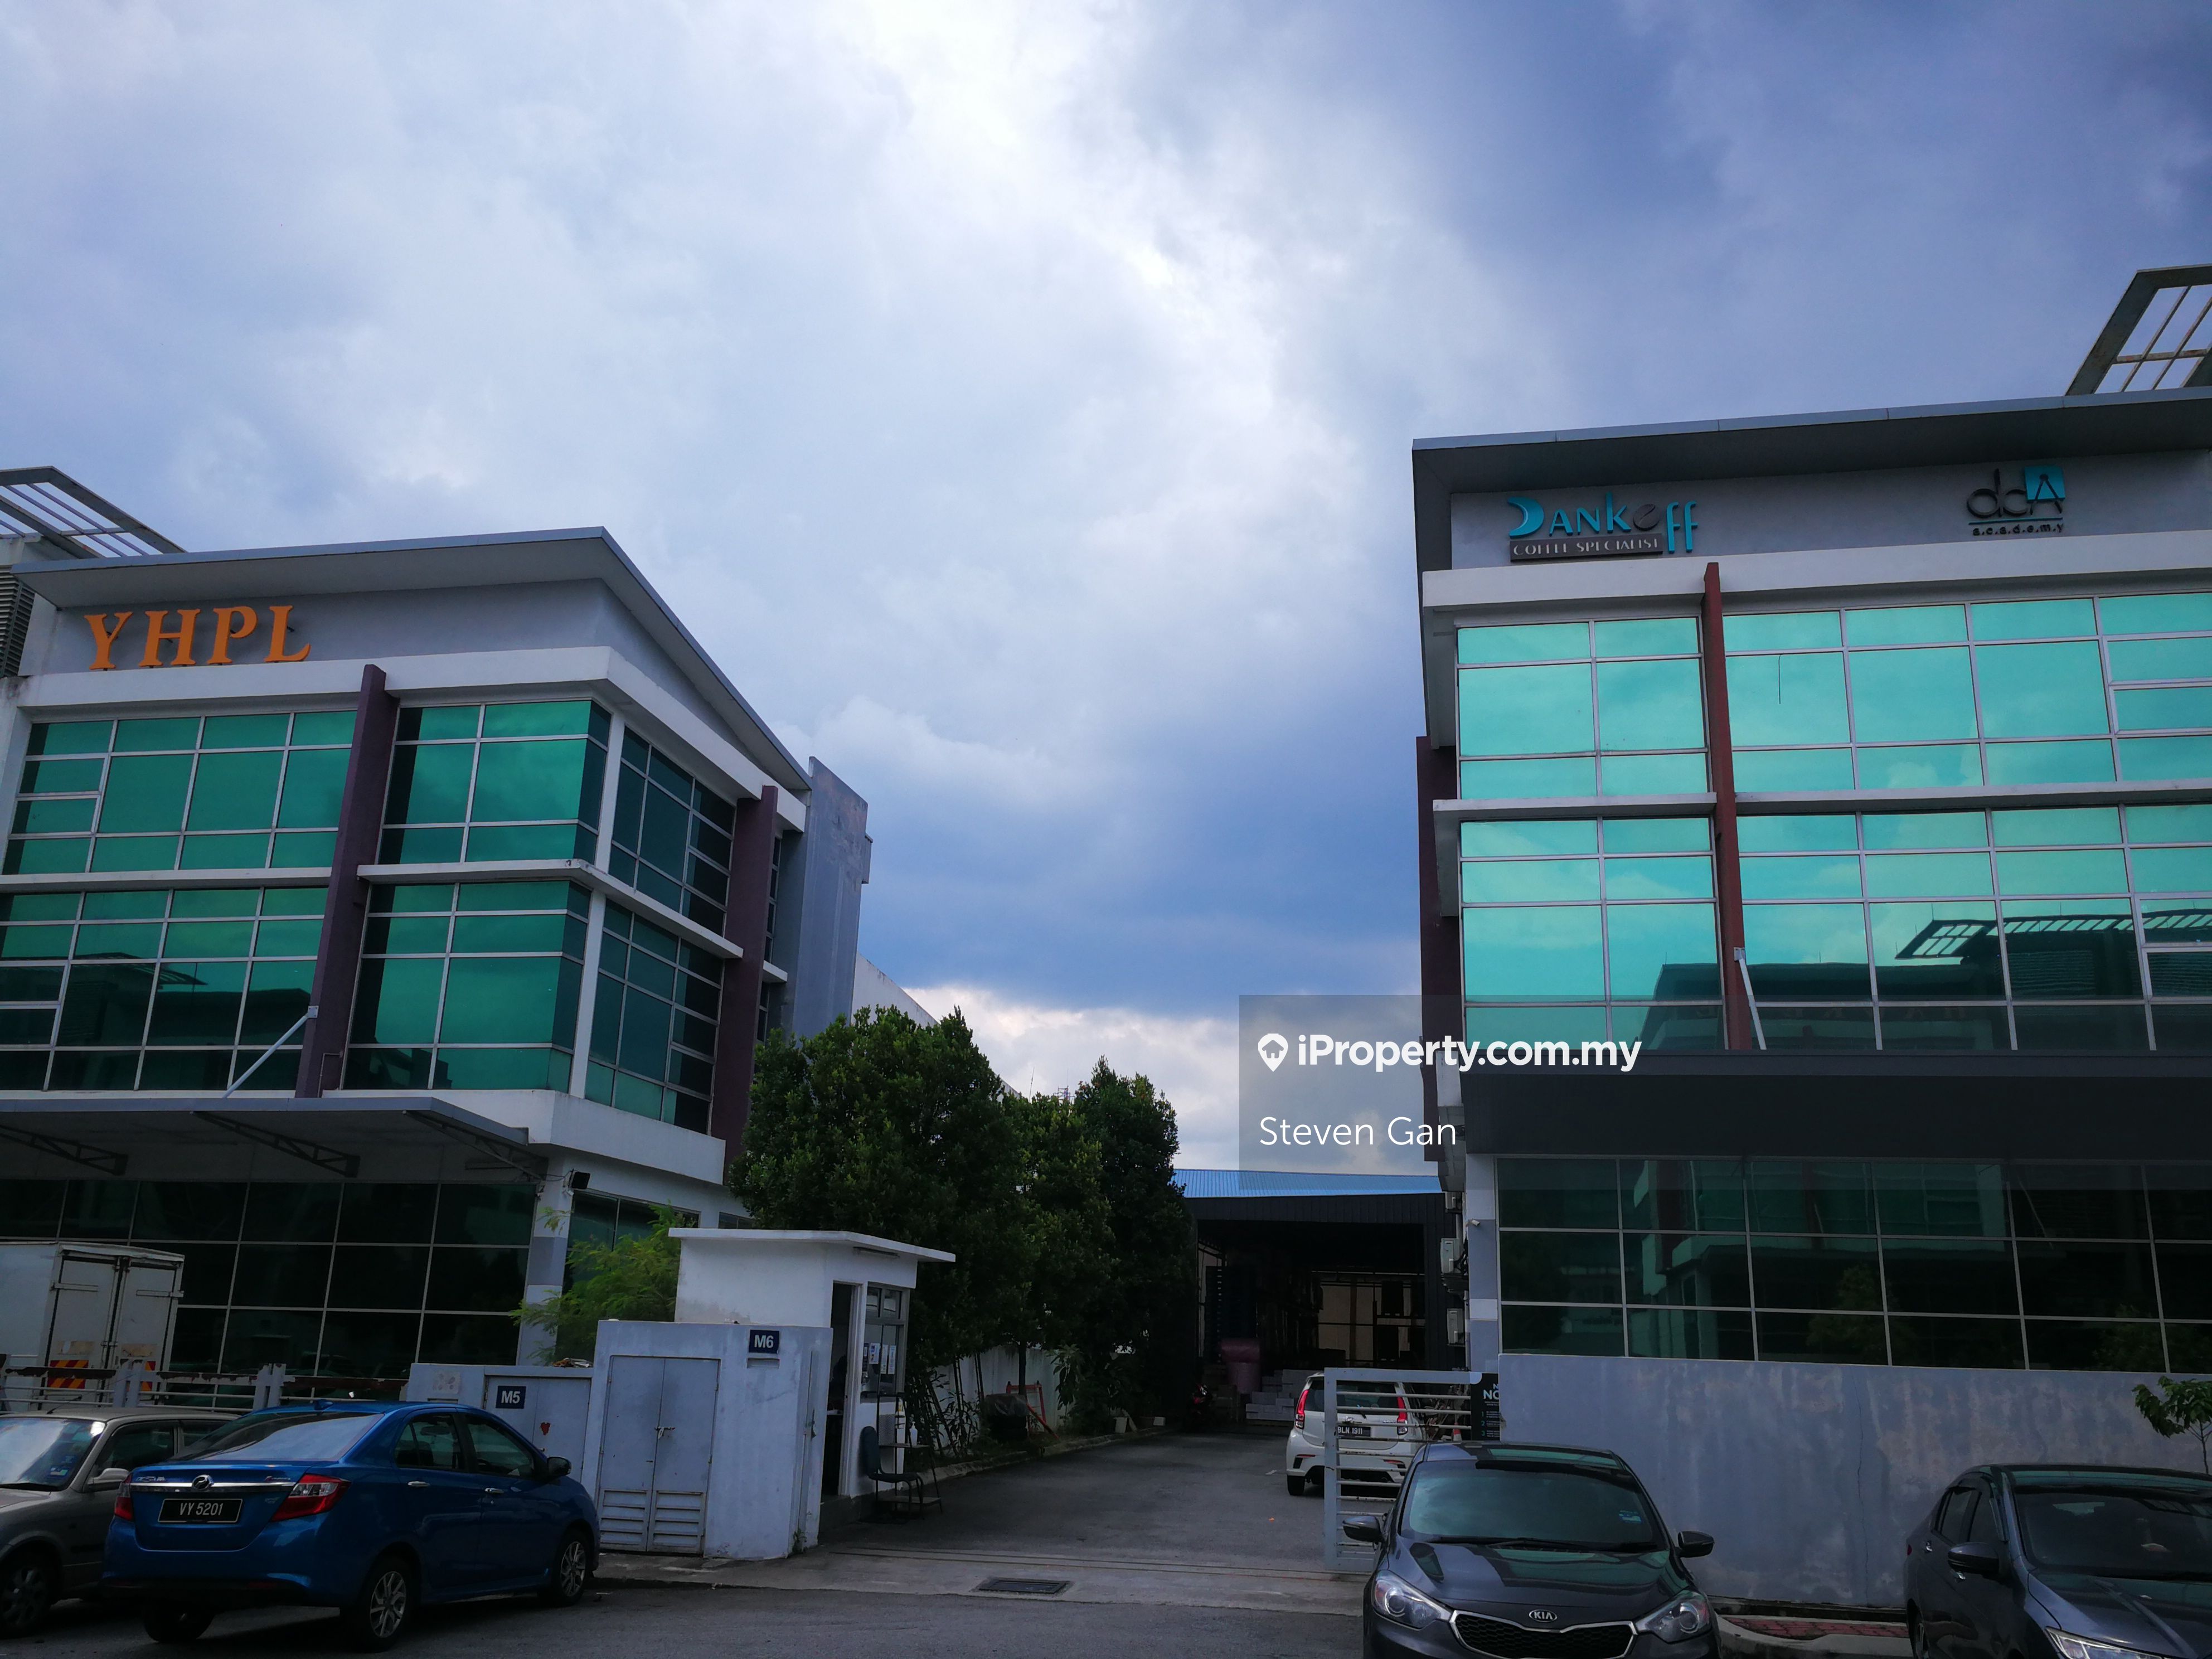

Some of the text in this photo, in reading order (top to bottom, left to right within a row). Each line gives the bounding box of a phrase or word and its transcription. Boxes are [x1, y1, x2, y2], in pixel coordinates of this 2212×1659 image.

[84, 605, 311, 670] YHPL
[754, 1335, 774, 1348] M6
[501, 1390, 521, 1404] M5
[180, 1502, 224, 1516] VY 5201
[1534, 1611, 1553, 1620] KIA
